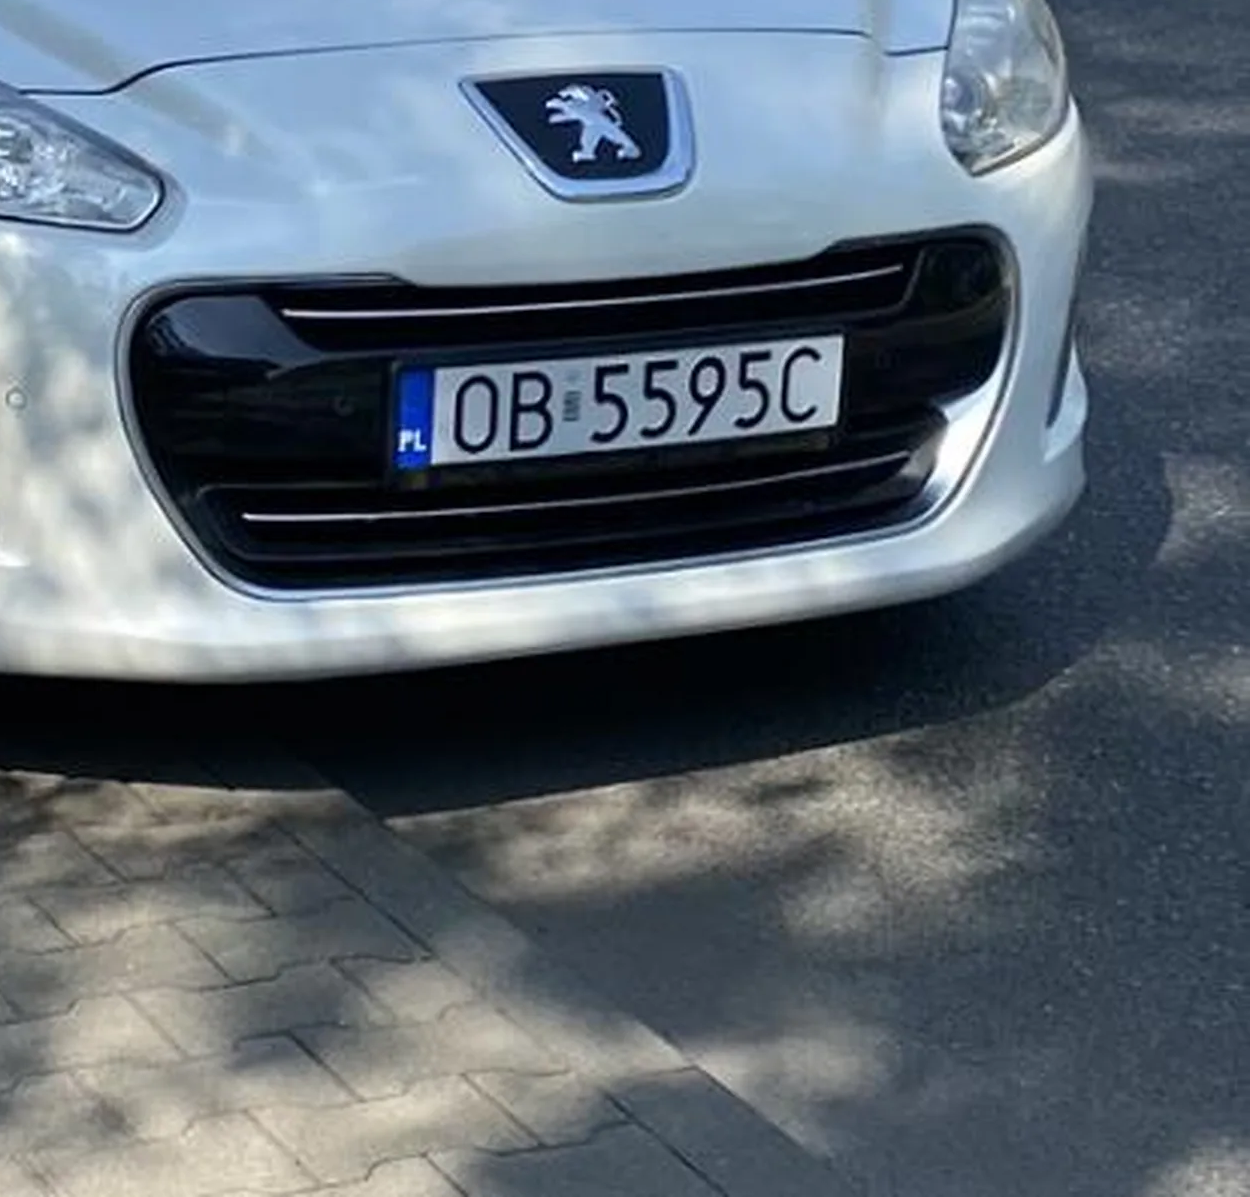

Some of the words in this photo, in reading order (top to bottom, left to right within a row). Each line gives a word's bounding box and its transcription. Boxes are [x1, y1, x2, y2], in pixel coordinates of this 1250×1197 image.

[453, 371, 554, 454] OB
[590, 346, 822, 444] 5595C
[398, 428, 427, 453] PL
